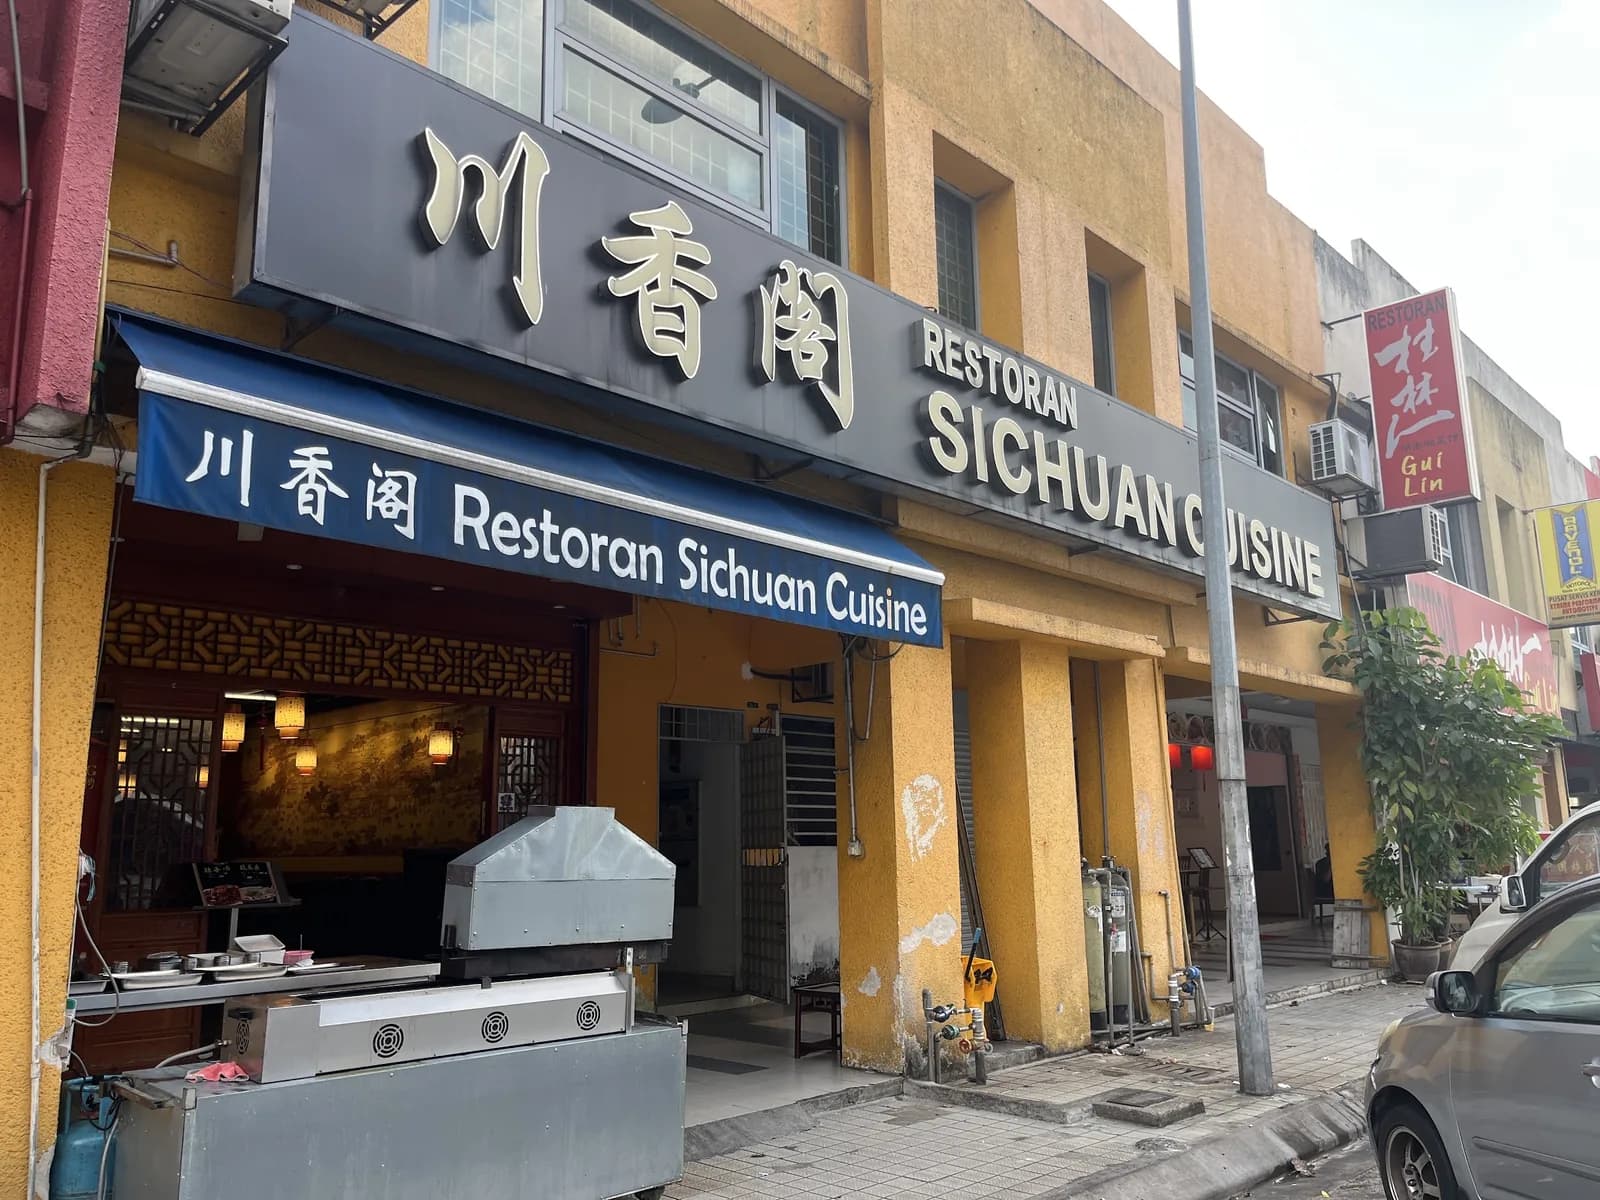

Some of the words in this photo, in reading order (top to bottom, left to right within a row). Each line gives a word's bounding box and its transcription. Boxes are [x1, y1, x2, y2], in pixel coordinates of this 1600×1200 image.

[1367, 295, 1446, 331] RESTORAN
[923, 318, 1078, 430] RESTORAN
[928, 390, 1177, 547] SICHUAN
[1401, 452, 1443, 476] Gui
[1404, 477, 1443, 497] Lin
[185, 428, 418, 541] 川香阁
[453, 483, 664, 584] Restoran
[678, 536, 817, 615] Sichuan
[825, 571, 928, 636] Cuisine
